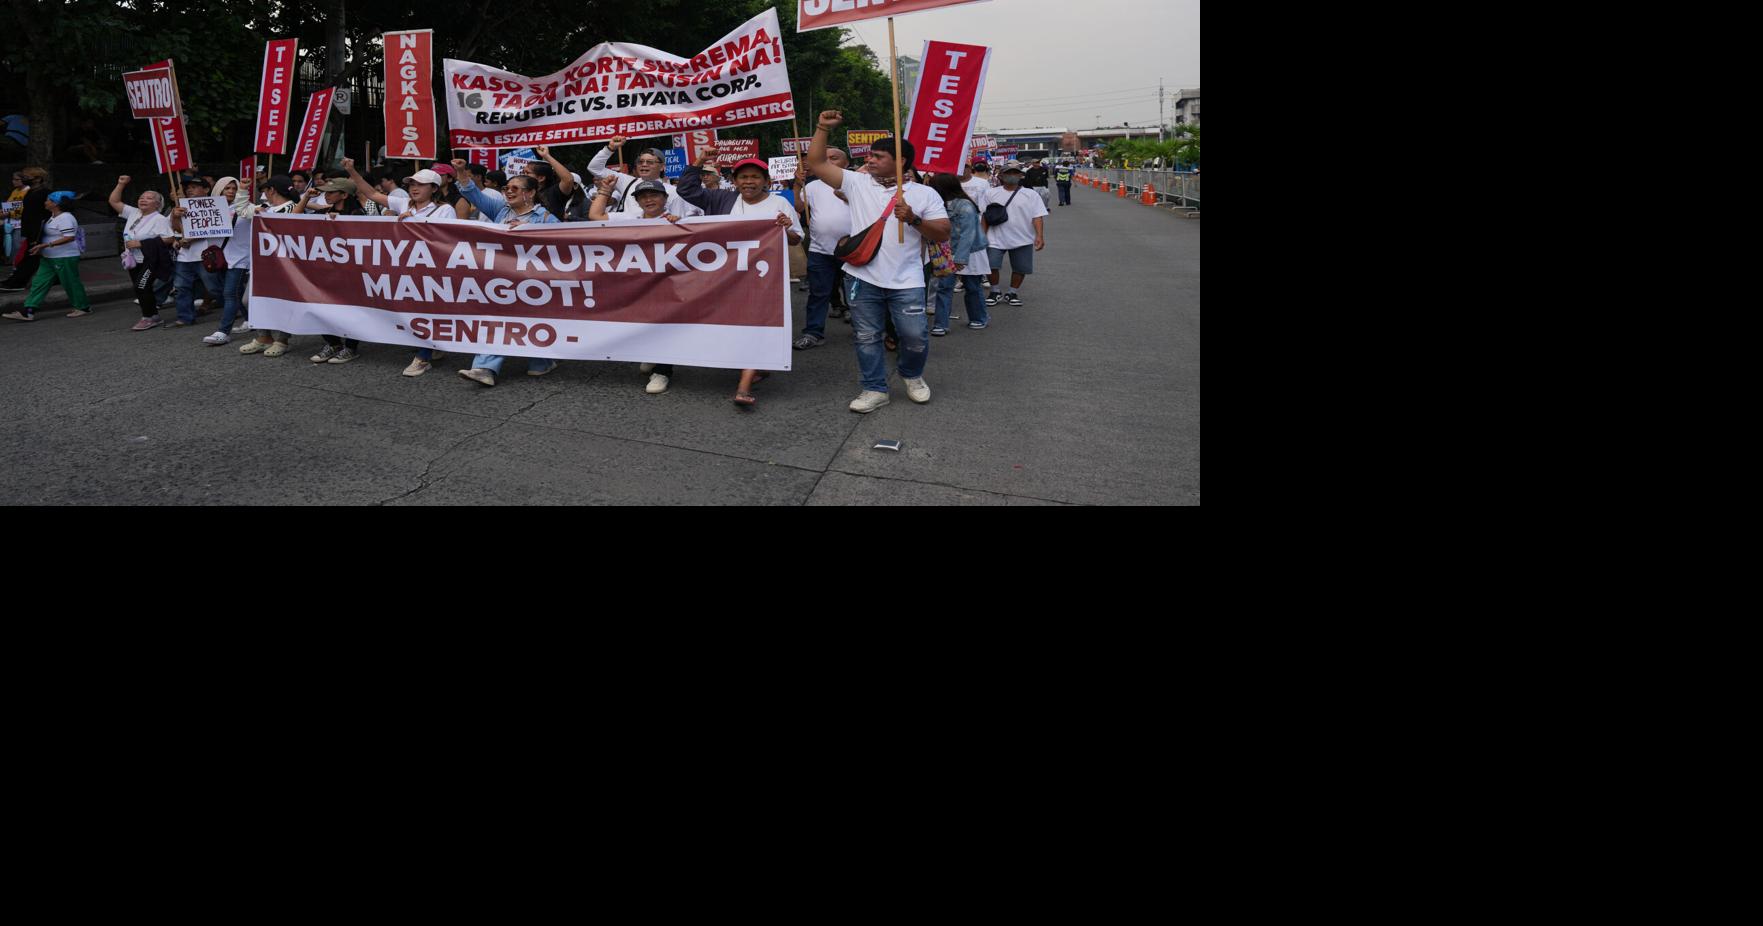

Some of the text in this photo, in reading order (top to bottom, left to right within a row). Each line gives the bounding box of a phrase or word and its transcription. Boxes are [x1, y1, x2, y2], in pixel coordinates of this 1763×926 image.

[127, 77, 171, 110] SENTRO
[266, 46, 286, 147] TESEF
[399, 33, 421, 156] NAGKAISA
[452, 73, 523, 92] KASO
[528, 81, 558, 95] SA
[563, 57, 637, 84] KORTE
[457, 92, 483, 109] 16
[565, 75, 609, 98] NA!
[730, 44, 781, 76] NA!
[476, 74, 762, 125] REPUBLIC VS. BIYAYA CORP.
[923, 50, 967, 165] TESEF
[300, 93, 326, 168] TESEF
[456, 135, 491, 145] TALA
[494, 131, 543, 145] ESTATE
[545, 123, 616, 140] SETTLERS
[618, 114, 713, 134] FEDERATION
[726, 100, 794, 122] SENTRO
[188, 199, 216, 209] POWER
[190, 216, 224, 230] PEOPLE!
[209, 208, 222, 217] THE
[258, 231, 769, 278] DINASTIYA AT KURAKOT,
[362, 272, 596, 309] MANAGOT!
[410, 317, 557, 347] SENTRO
